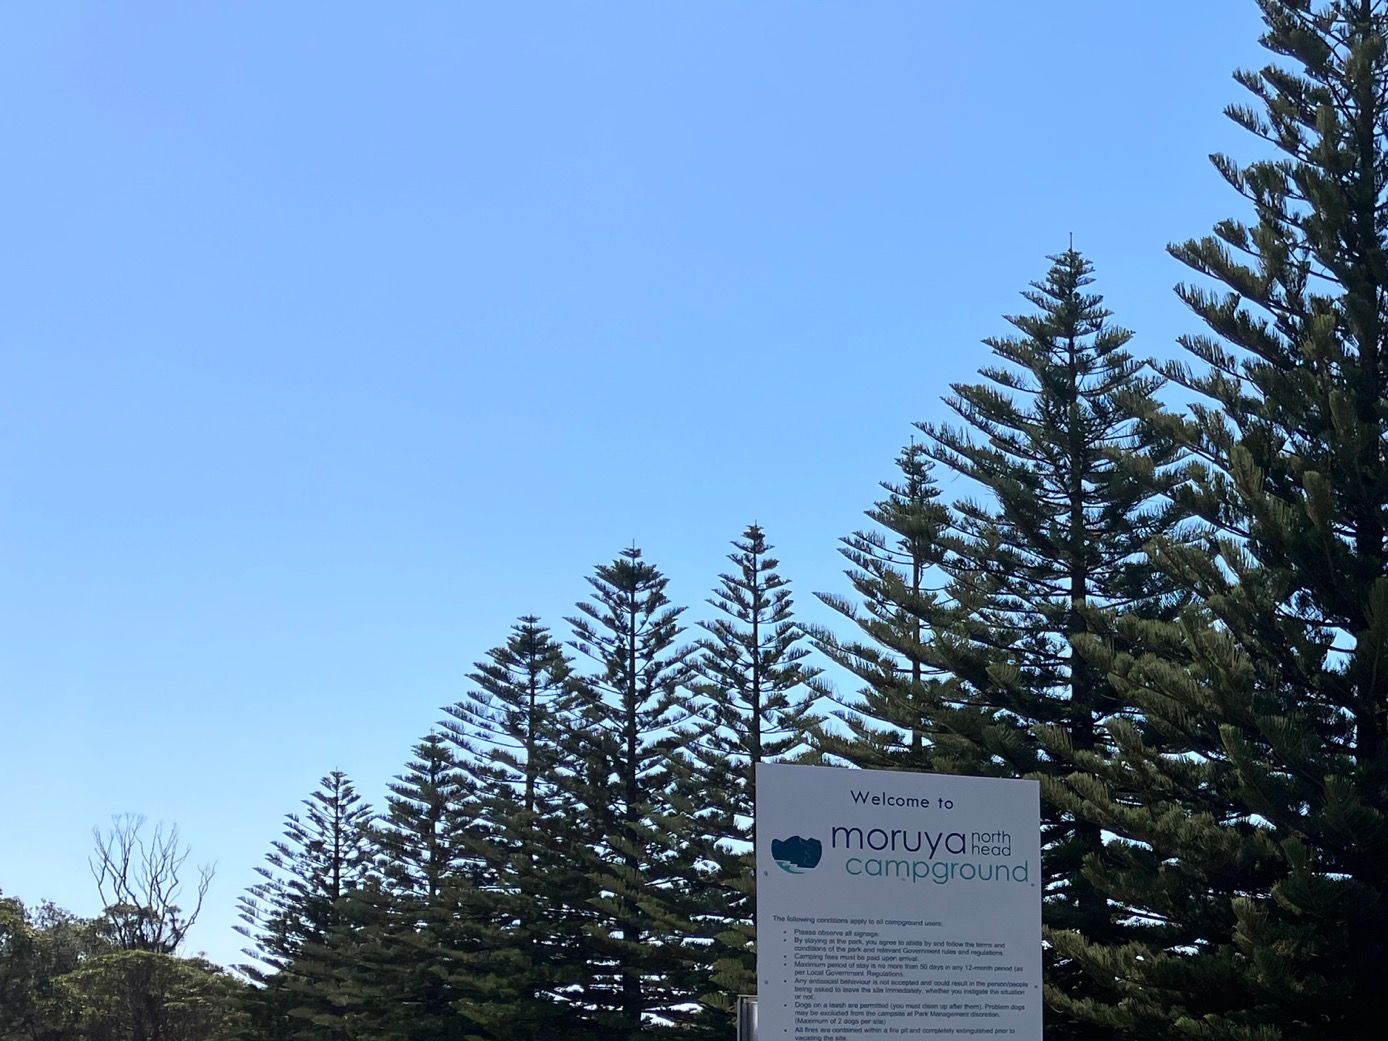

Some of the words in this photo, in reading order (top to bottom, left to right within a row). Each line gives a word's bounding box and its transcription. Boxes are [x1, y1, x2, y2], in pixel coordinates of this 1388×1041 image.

[850, 790, 930, 808] Welcome
[938, 797, 954, 810] to
[832, 826, 966, 860] moruya
[972, 830, 1012, 844] north
[972, 843, 1012, 857] head
[846, 857, 1029, 885] campground
[787, 916, 815, 924] following
[885, 919, 923, 927] campground
[805, 937, 827, 945] staying
[847, 946, 861, 954] park
[794, 953, 823, 961] Camping
[856, 962, 869, 970] stay
[994, 965, 1013, 973] period
[878, 1010, 905, 1018] campsite
